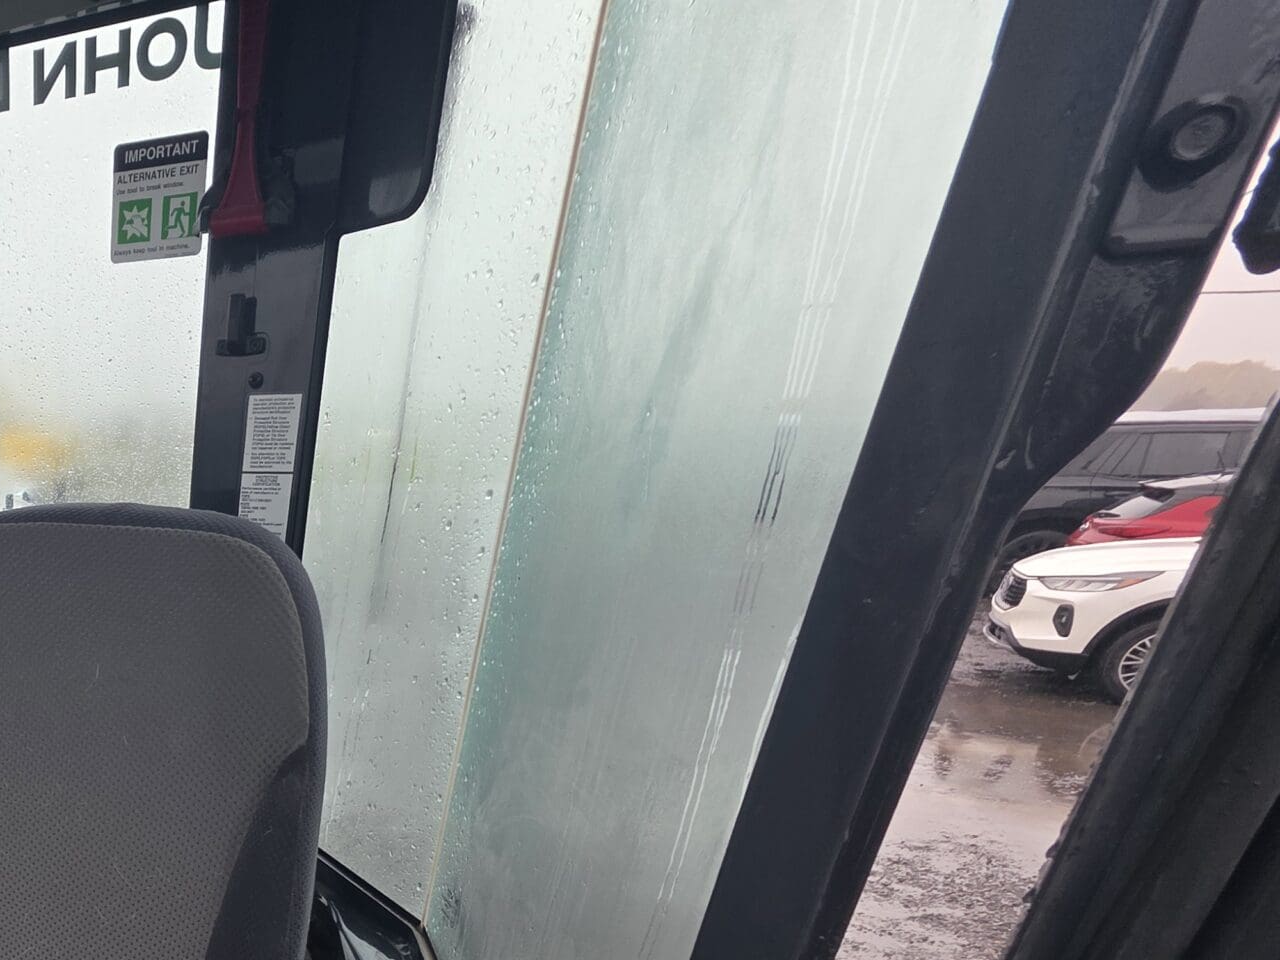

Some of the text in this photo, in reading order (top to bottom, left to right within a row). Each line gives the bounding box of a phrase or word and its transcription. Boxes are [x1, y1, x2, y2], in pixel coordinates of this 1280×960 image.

[124, 139, 199, 164] IMPORTANT
[116, 163, 200, 185] ALTERNATIVE EXIT
